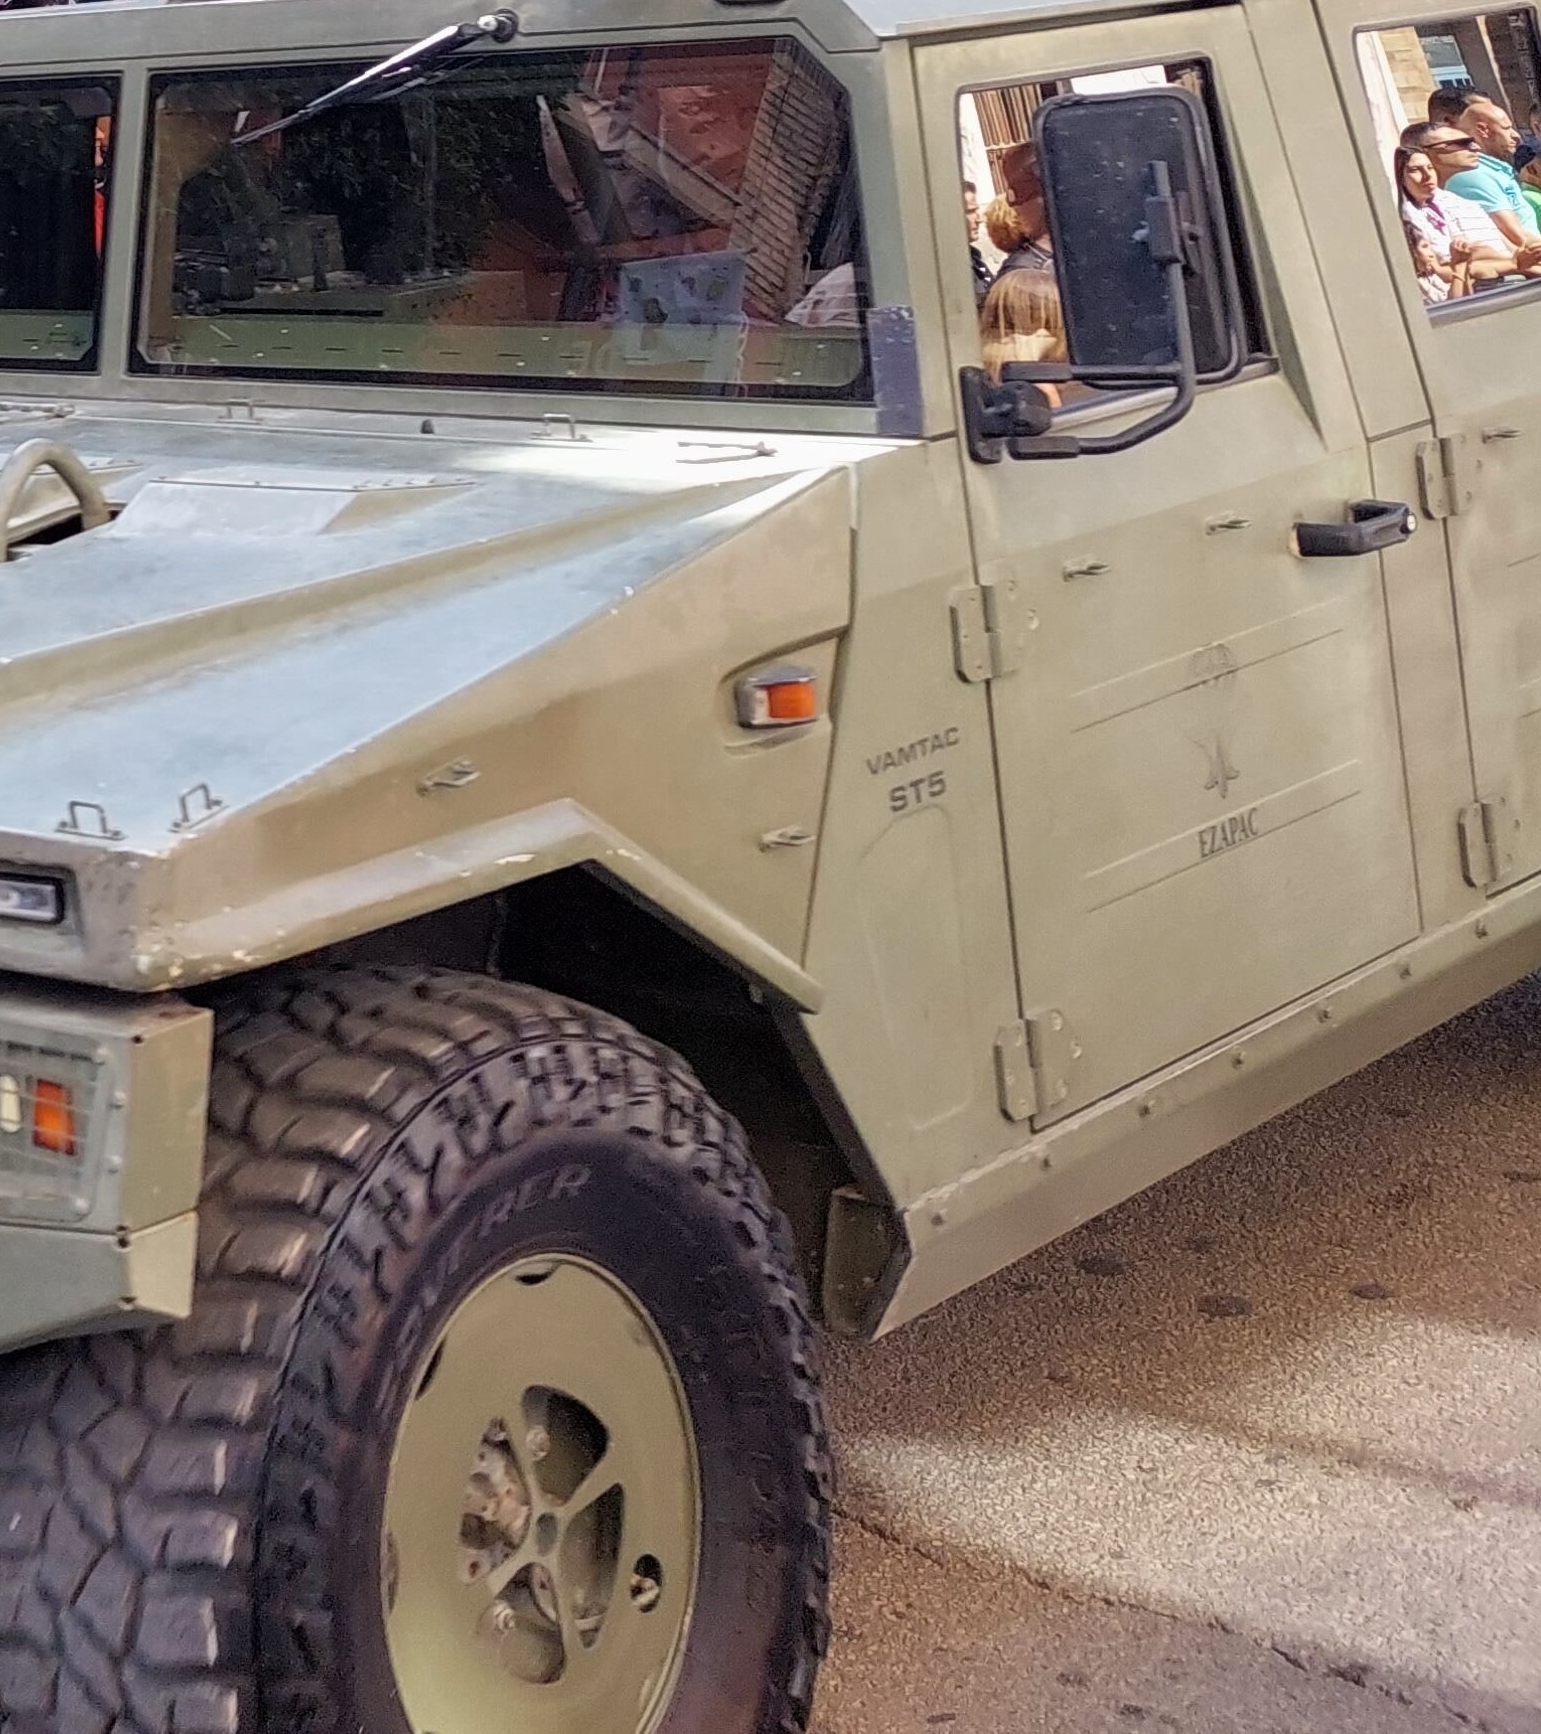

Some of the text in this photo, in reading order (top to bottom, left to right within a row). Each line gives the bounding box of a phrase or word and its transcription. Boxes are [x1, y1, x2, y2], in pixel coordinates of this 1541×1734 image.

[865, 726, 960, 776] VAMTAC
[888, 769, 947, 813] ST5
[1198, 807, 1259, 859] EZAPAC
